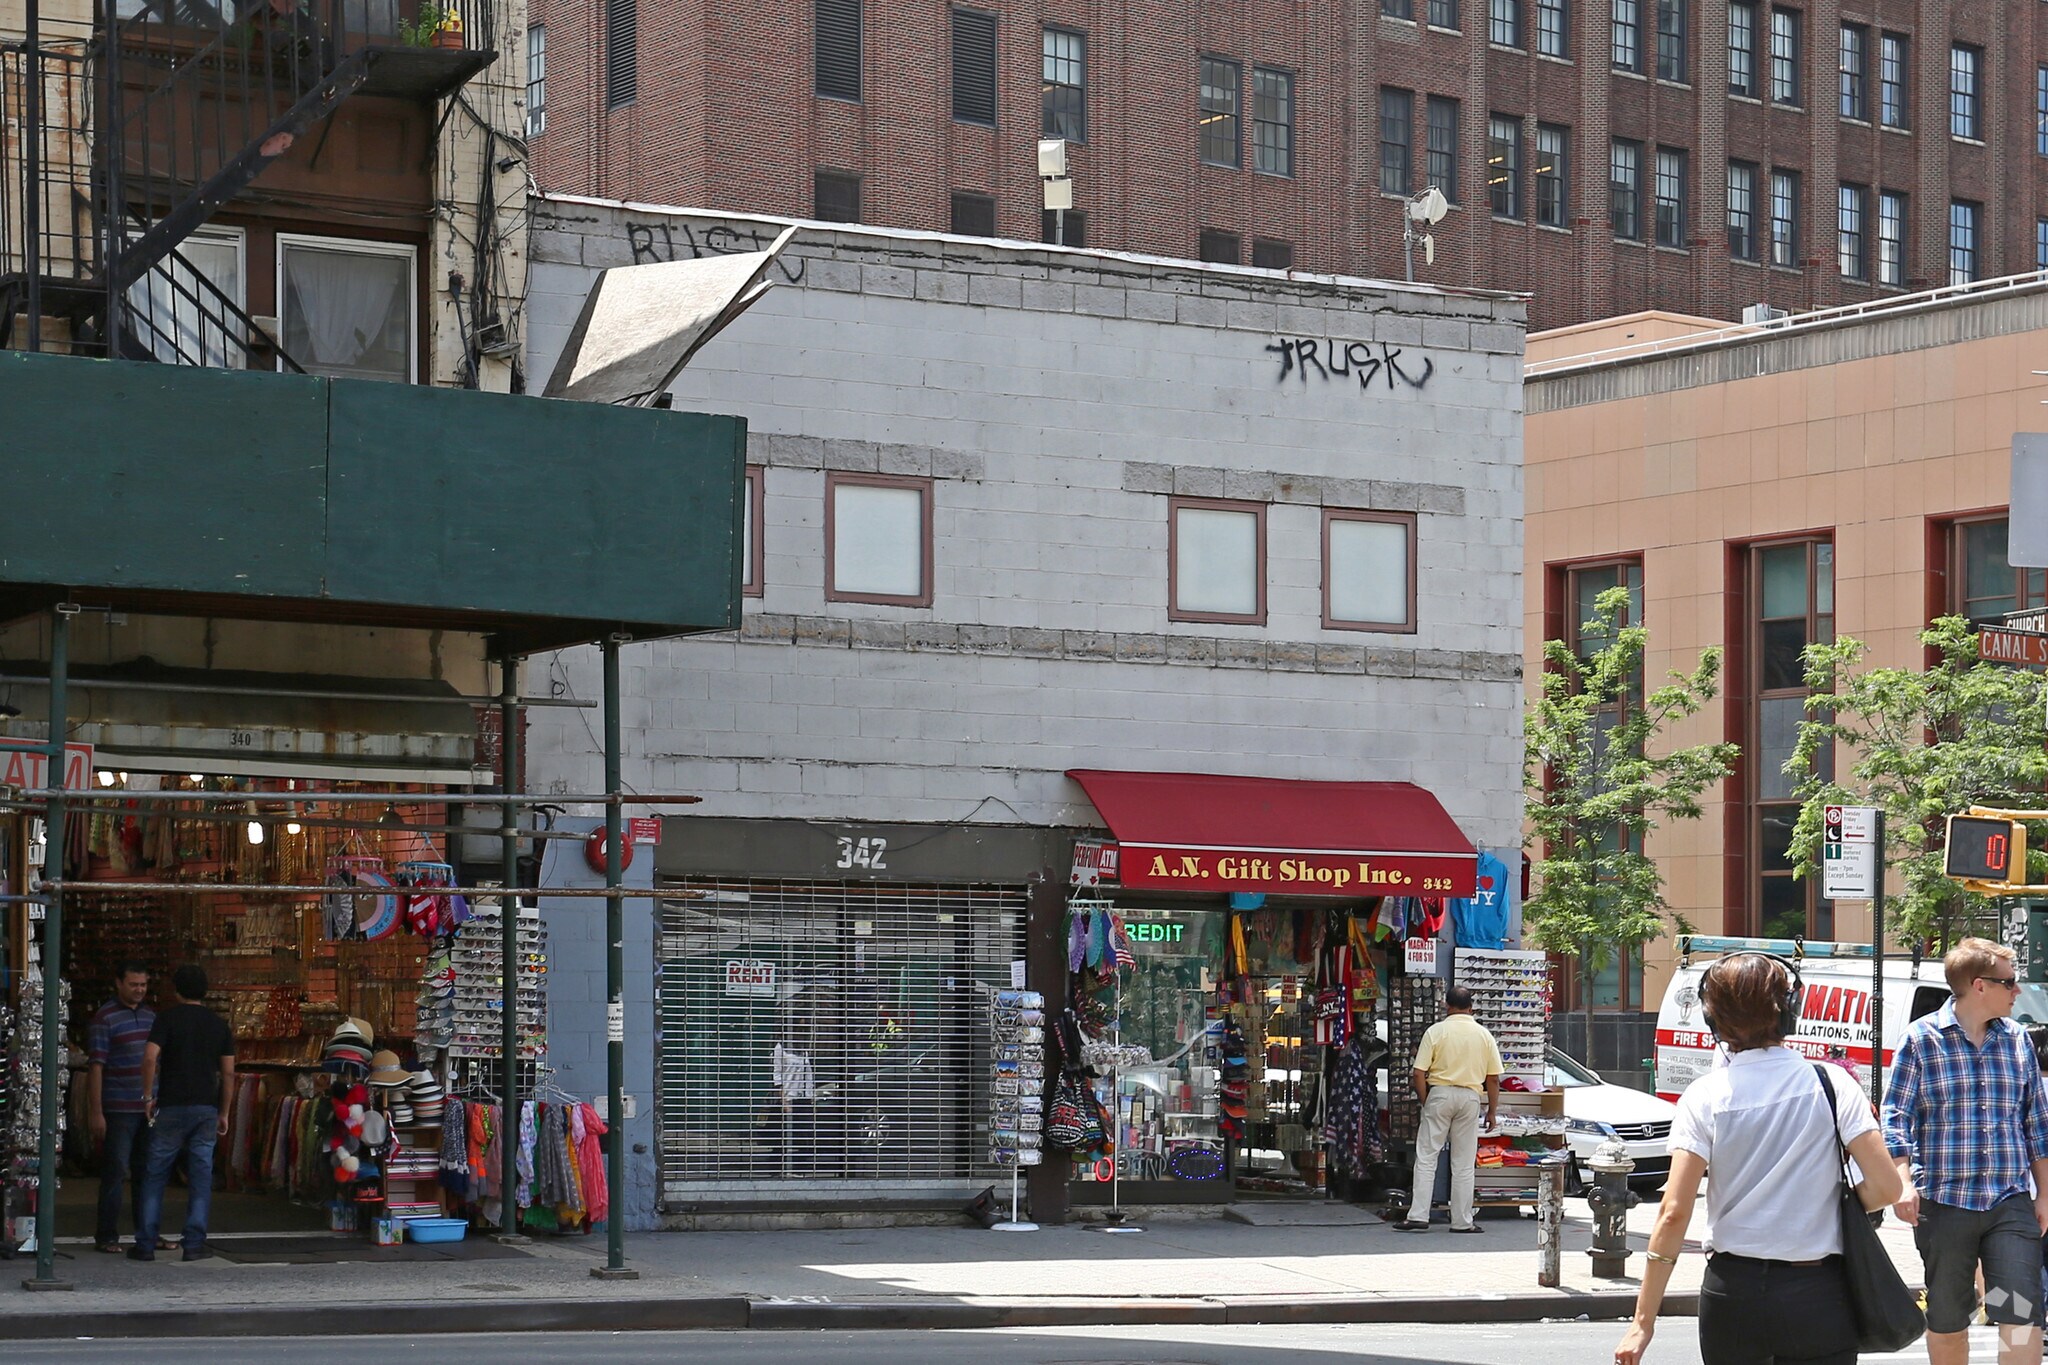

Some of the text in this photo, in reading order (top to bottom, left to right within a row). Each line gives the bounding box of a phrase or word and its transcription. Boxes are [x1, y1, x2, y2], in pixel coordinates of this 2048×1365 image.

[2007, 614, 2045, 633] CHURCH
[1982, 631, 2030, 661] CANAL
[231, 732, 251, 746] 340
[837, 837, 887, 869] 342
[1100, 849, 1117, 868] ATM
[1147, 854, 1412, 888] A.N. Gift Shop Inc.
[1423, 877, 1453, 890] 342
[1408, 940, 1434, 951] MAGNETS
[1413, 952, 1423, 962] FOR
[1424, 952, 1434, 963] $10
[728, 962, 773, 984] RENT
[1322, 1002, 1335, 1011] NY
[1673, 1032, 1698, 1046] FIRE
